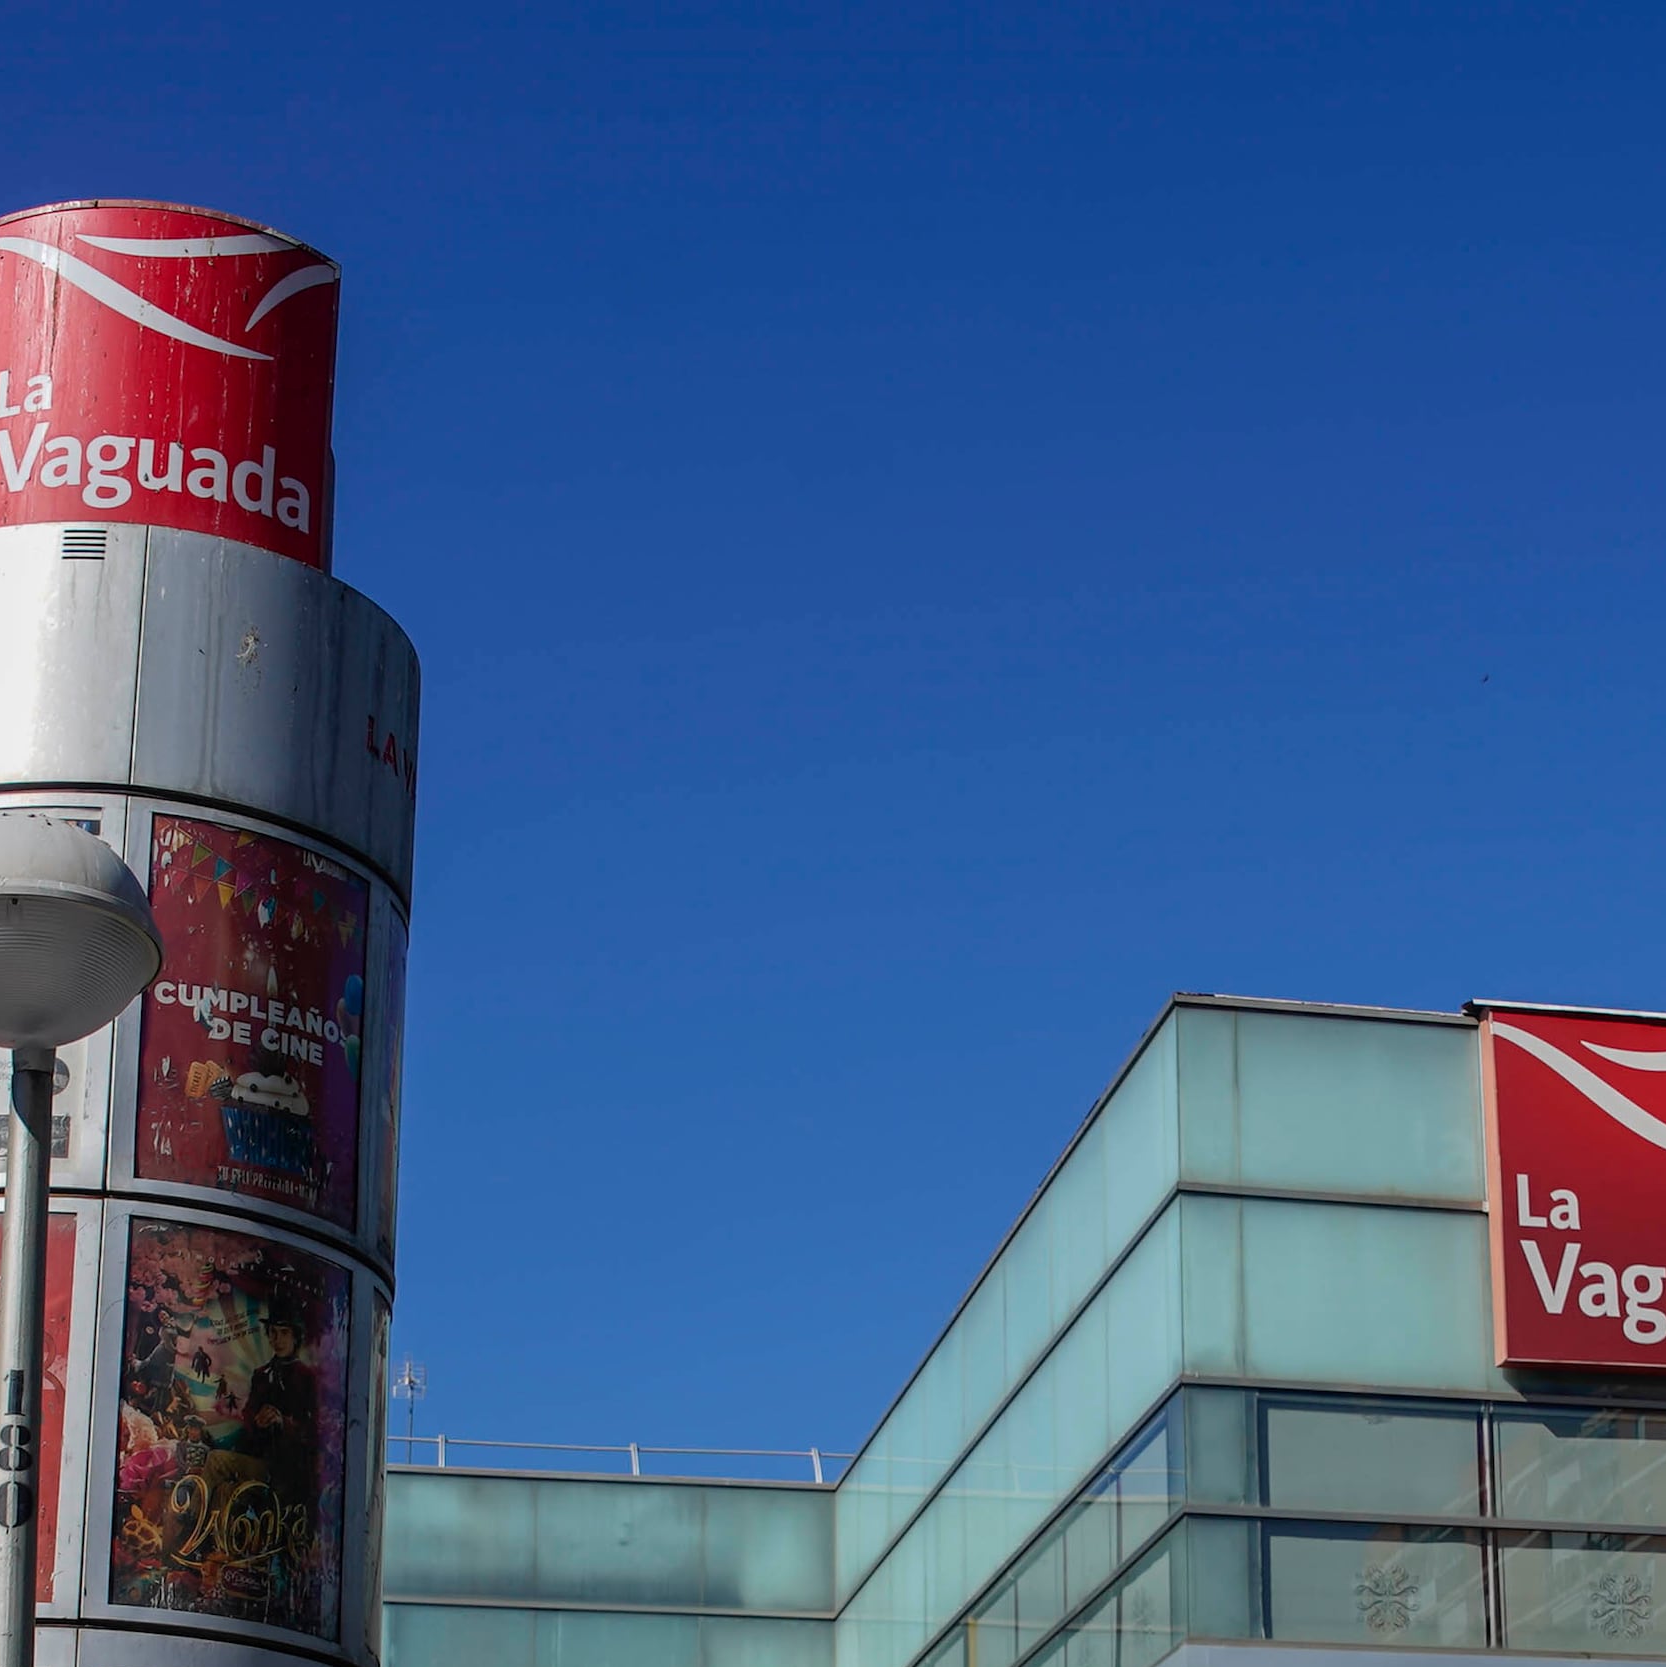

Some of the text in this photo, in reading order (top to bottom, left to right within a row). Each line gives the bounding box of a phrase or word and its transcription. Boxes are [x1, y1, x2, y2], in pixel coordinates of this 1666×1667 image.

[208, 1016, 252, 1046] DE
[260, 1026, 323, 1067] CINE
[1516, 1173, 1582, 1230] La
[170, 1474, 307, 1564] Wonka
